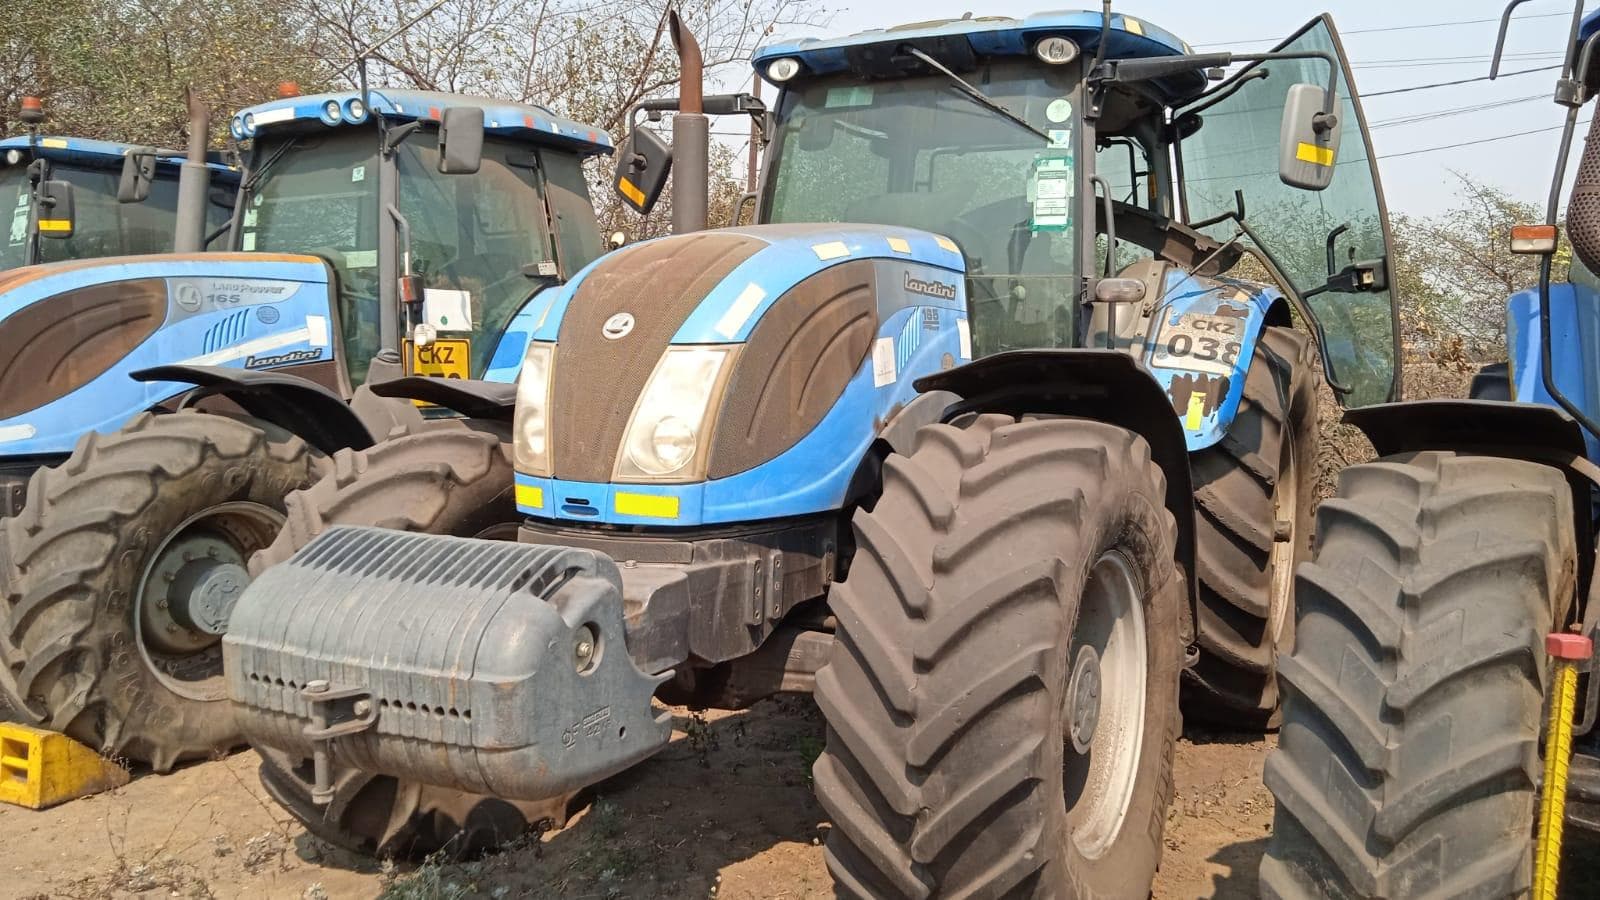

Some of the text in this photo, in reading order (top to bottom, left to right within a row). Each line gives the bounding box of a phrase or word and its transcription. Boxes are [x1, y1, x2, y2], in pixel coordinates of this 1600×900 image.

[904, 270, 956, 300] Landini
[206, 294, 241, 304] 165
[1191, 319, 1236, 336] CKZ
[245, 348, 323, 369] Landini
[418, 346, 455, 365] CKZ
[1167, 333, 1242, 368] 038
